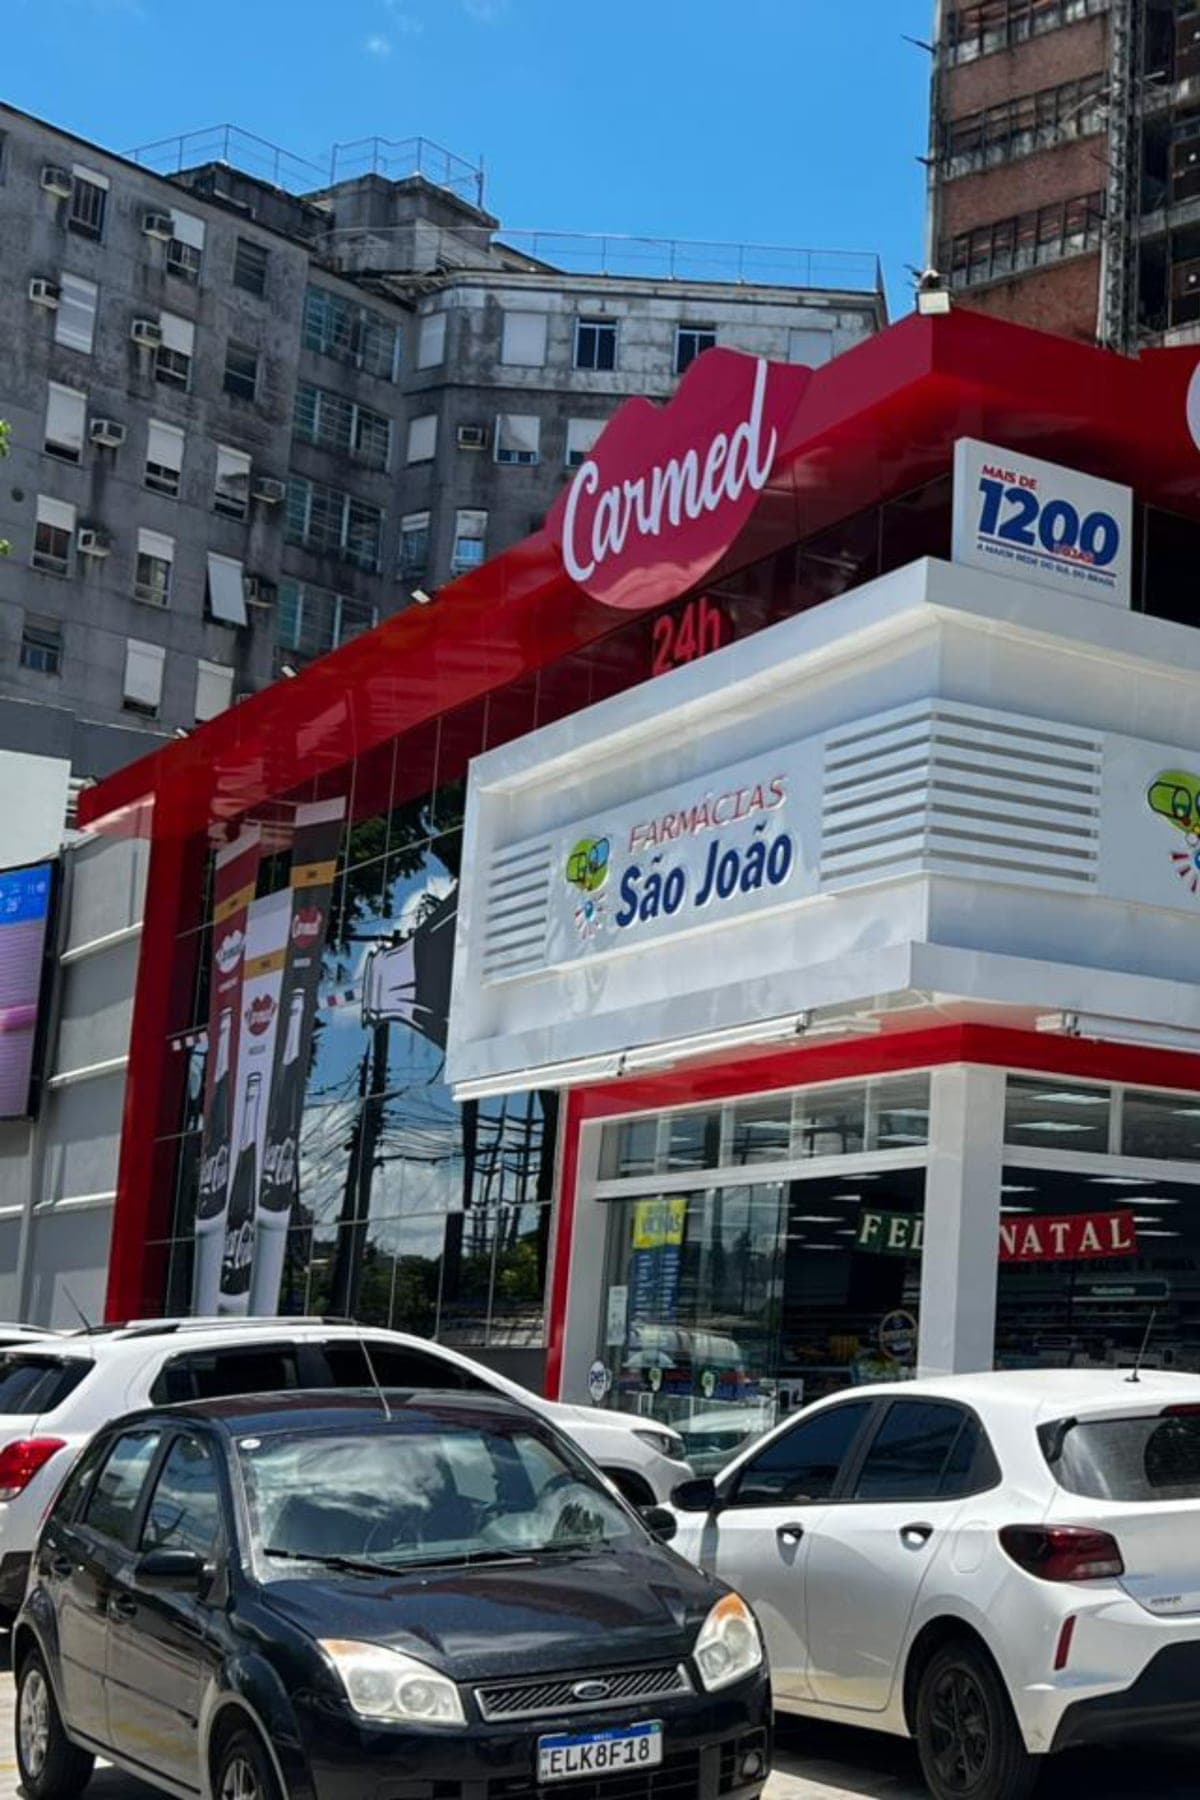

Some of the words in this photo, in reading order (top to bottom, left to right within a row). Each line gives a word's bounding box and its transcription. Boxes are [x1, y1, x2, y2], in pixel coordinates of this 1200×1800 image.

[562, 357, 777, 582] Carmed
[982, 464, 1016, 484] MAIS
[1018, 476, 1037, 490] DE
[979, 477, 1120, 566] 1200
[652, 598, 721, 677] 24h
[629, 774, 787, 852] FARMÁCIAS
[616, 853, 686, 928] São
[694, 820, 792, 906] João
[1000, 1217, 1132, 1255] NATAL
[550, 1737, 650, 1774] ELK8F18
